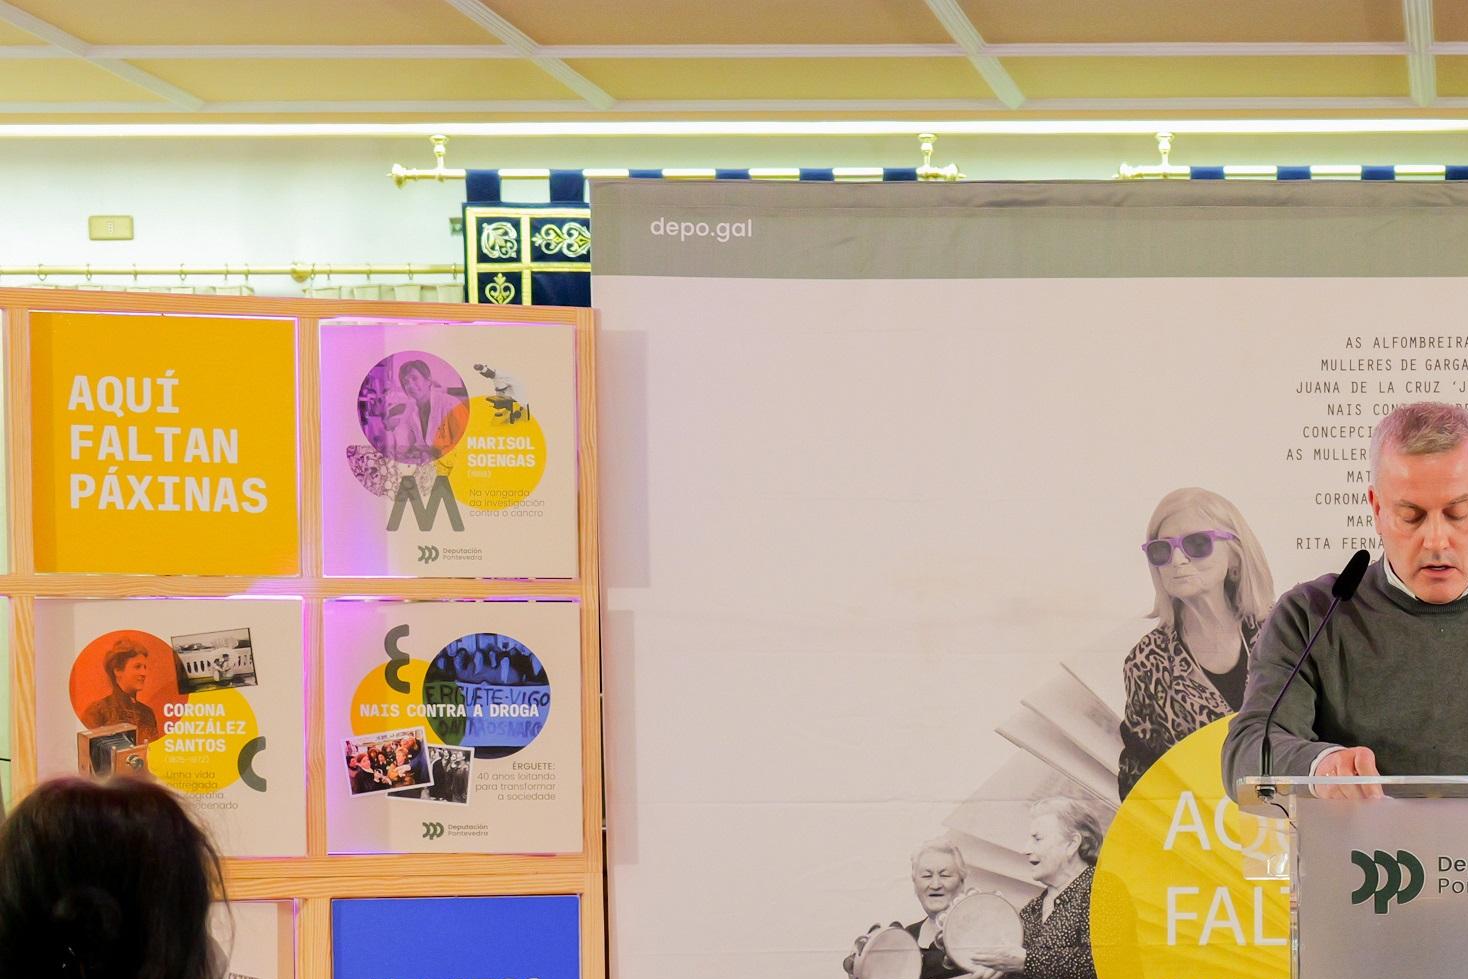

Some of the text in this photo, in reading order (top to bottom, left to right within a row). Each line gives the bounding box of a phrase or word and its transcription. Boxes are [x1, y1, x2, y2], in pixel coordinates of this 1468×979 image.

[650, 216, 753, 243] depo.gal
[1346, 337, 1362, 349] AS
[1321, 359, 1393, 371] MULLERES
[1401, 359, 1417, 371] DE
[68, 370, 180, 416] AQUÍ
[1296, 381, 1340, 394] JUANA
[1351, 381, 1367, 393] DE
[1379, 381, 1395, 393] LA
[1405, 381, 1441, 393] CRUZ
[1327, 403, 1362, 416] NAIS
[1303, 426, 1373, 438] CONCEPCI
[70, 424, 239, 465] FALTAN
[467, 436, 535, 450] MARISOL
[467, 453, 536, 468] SOENGAS
[1286, 449, 1303, 461] AS
[1313, 448, 1367, 461] MULLER
[1347, 471, 1371, 483] MAT
[70, 471, 268, 514] PÁXINAS
[1315, 493, 1369, 505] CORONA
[1347, 515, 1373, 527] MAR
[1296, 538, 1330, 550] RITA
[1342, 533, 1384, 549] FERNÁ
[163, 703, 225, 717] CORONA
[360, 703, 539, 717] NAIS CONTRA A DROGA
[164, 718, 247, 735] GONZÁLEZ
[165, 738, 226, 752] SANTOS
[491, 773, 515, 781] anos
[517, 772, 556, 781] loitando
[475, 782, 556, 792] para transformar
[1166, 886, 1290, 946] FAL
